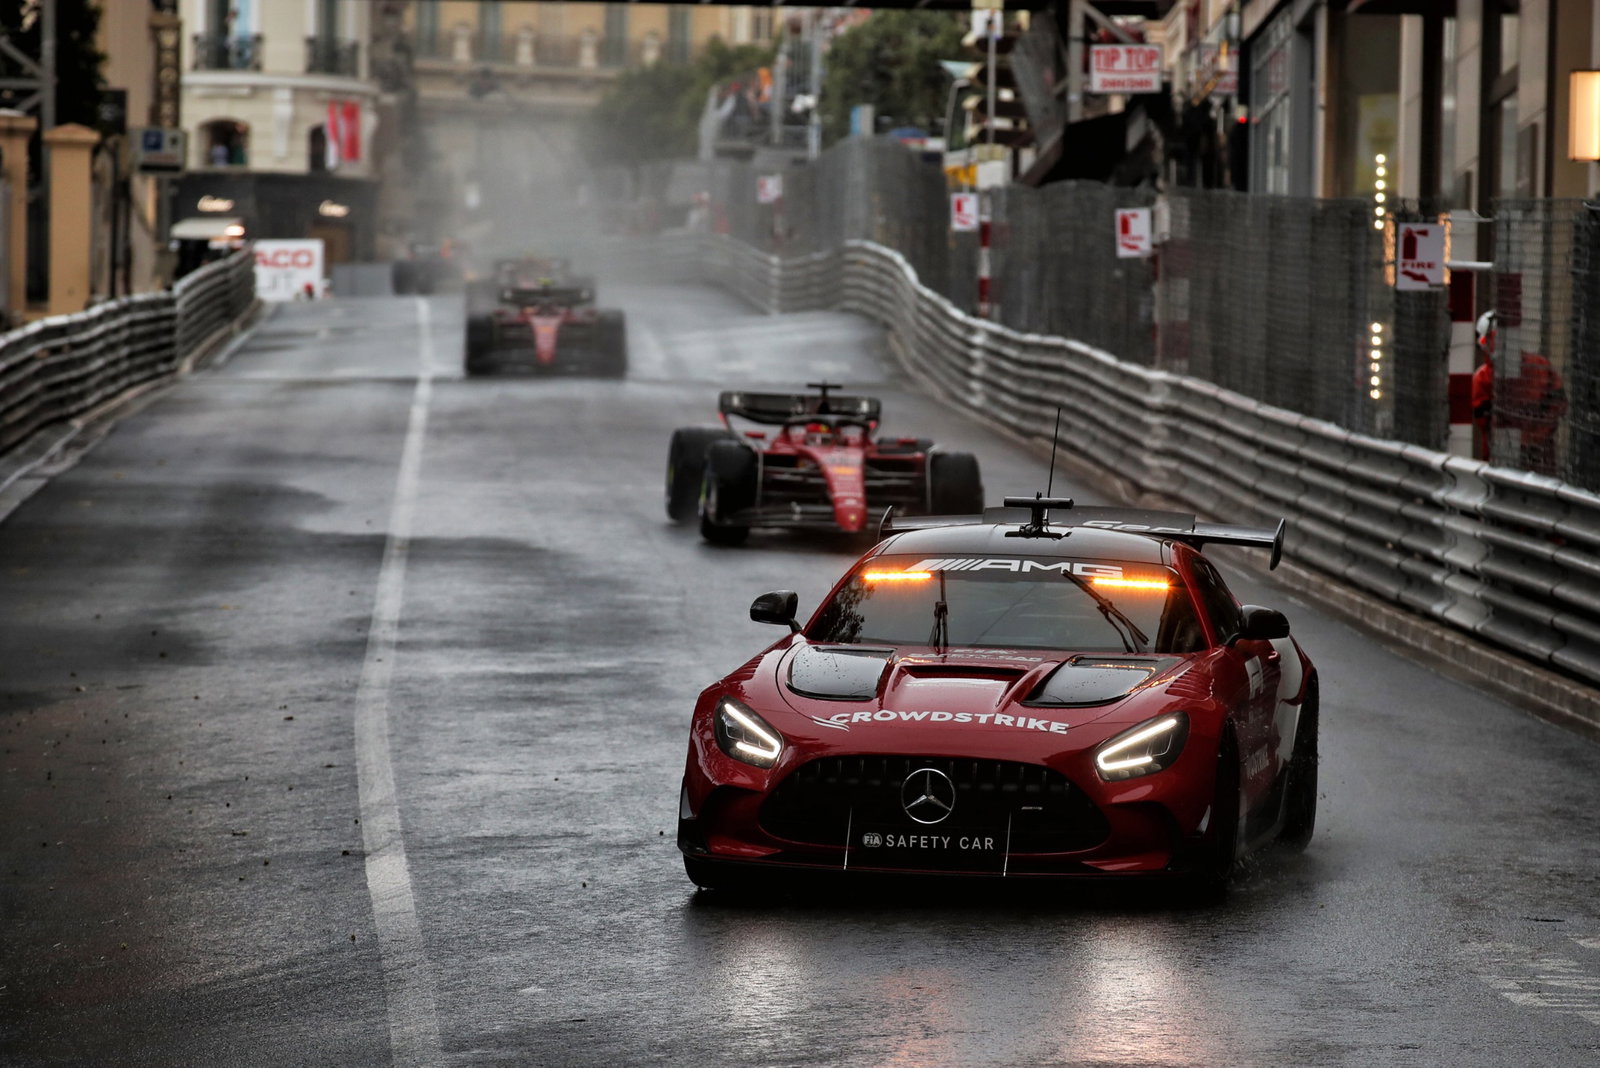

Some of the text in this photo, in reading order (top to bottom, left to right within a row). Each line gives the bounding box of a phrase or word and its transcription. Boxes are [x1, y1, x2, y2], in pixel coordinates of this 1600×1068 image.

[1092, 49, 1159, 70] TIP TOP
[1401, 261, 1436, 270] FIRE
[971, 559, 1124, 579] AMG
[828, 709, 1069, 735] CROWDSTRIKE
[885, 834, 951, 850] SAFETY
[959, 836, 994, 851] CAR
